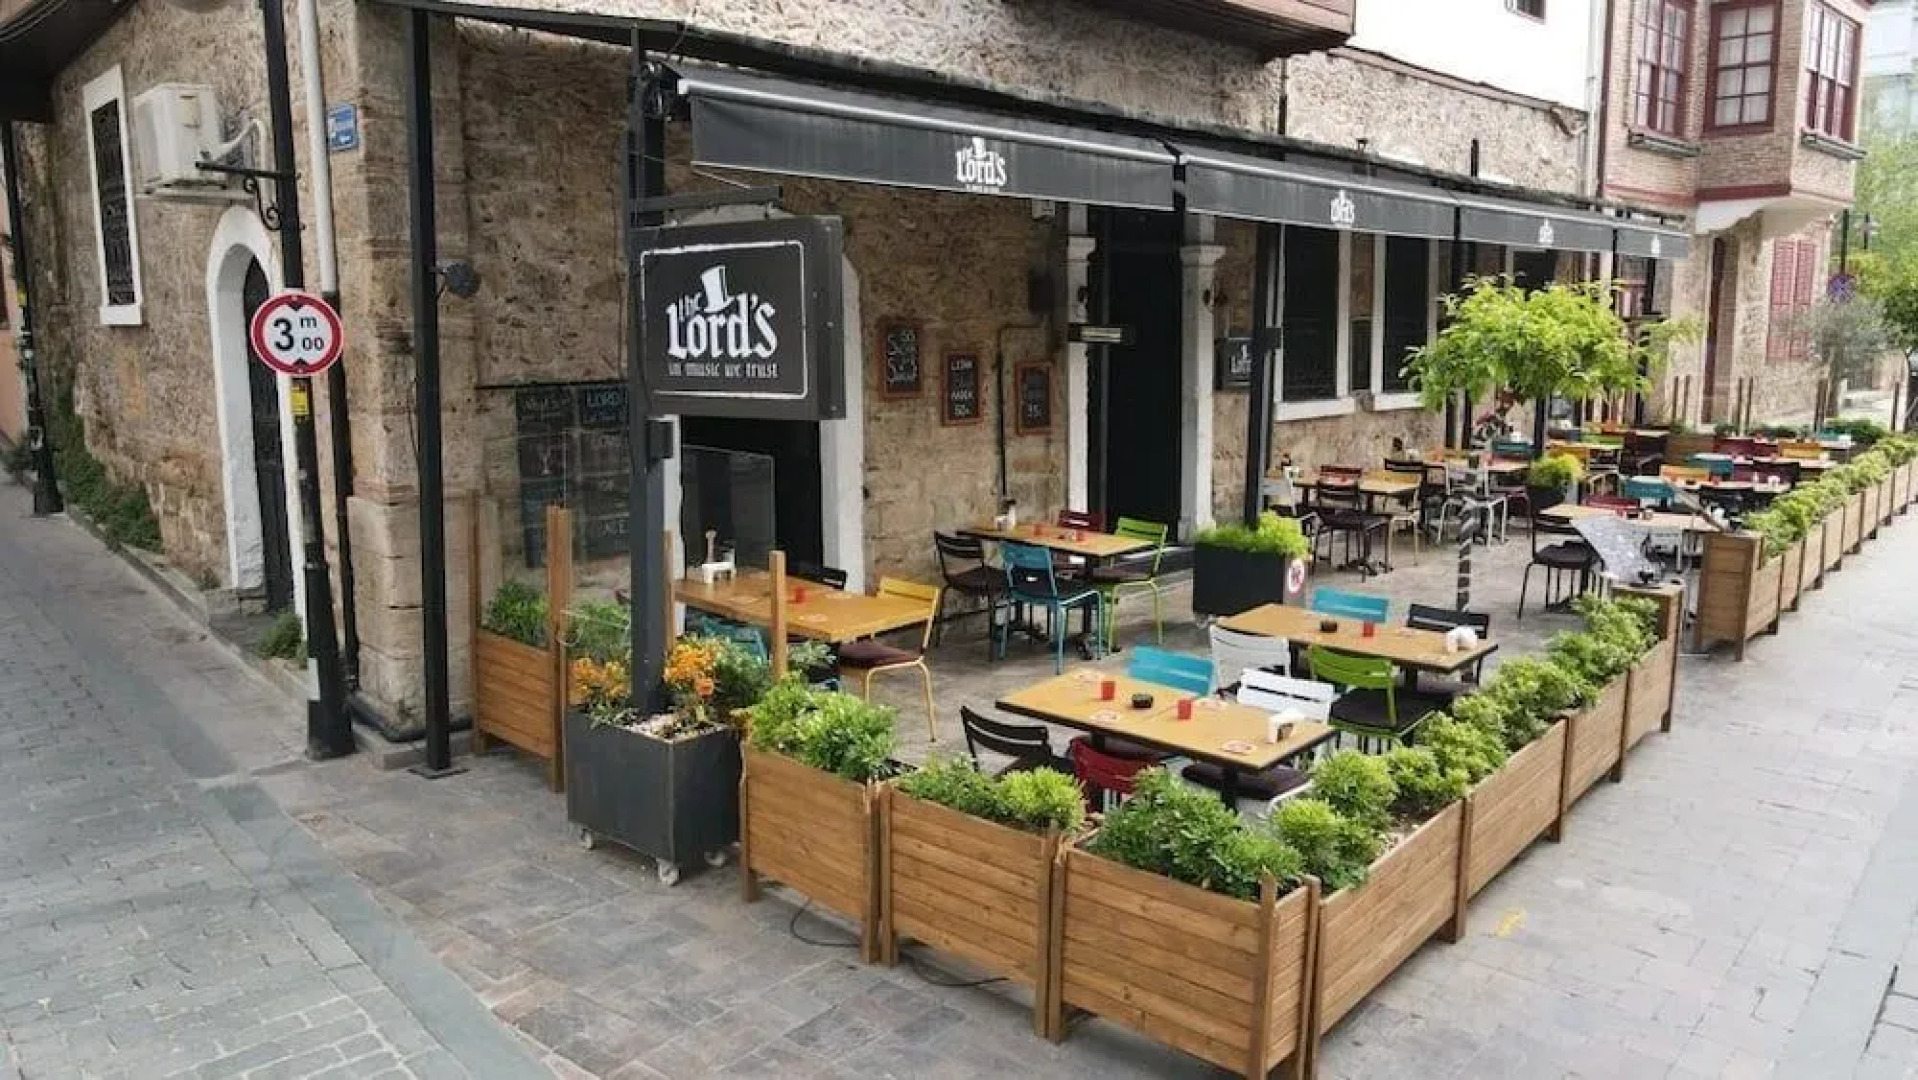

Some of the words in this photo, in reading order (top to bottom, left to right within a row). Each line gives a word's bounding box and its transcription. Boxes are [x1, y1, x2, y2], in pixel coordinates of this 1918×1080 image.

[300, 316, 317, 328] m
[273, 317, 295, 351] 3
[302, 337, 325, 351] 00
[685, 362, 720, 377] music
[724, 362, 742, 378] we
[745, 362, 778, 378] trust
